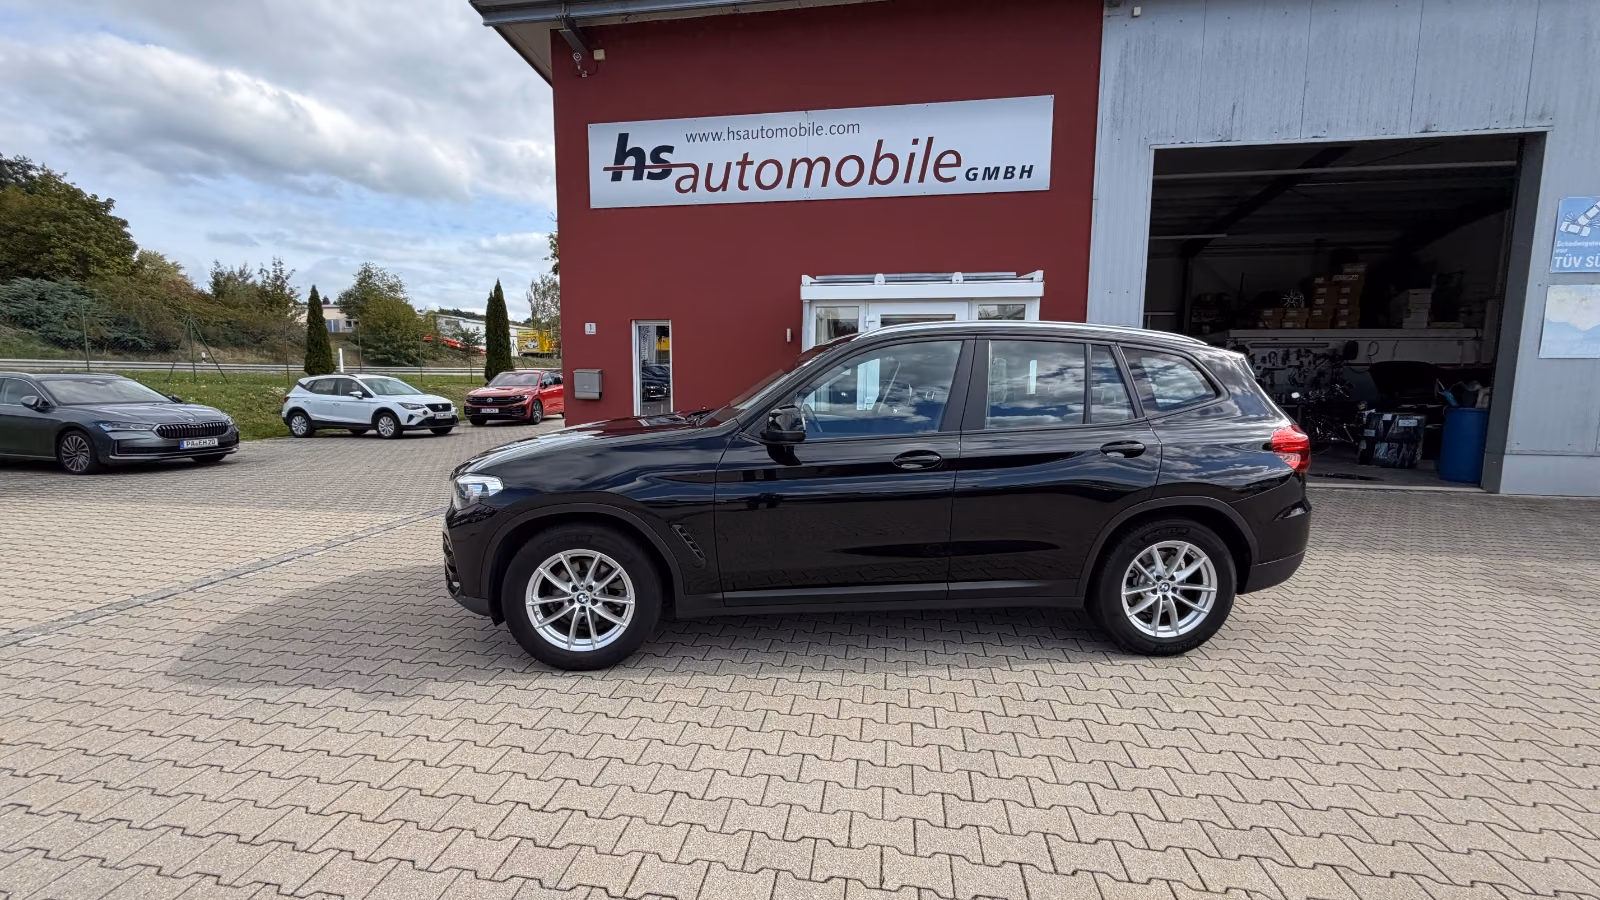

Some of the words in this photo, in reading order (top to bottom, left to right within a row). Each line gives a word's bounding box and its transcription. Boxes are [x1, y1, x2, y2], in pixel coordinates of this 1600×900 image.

[685, 121, 861, 143] www.hsautomobile.com
[964, 164, 1034, 182] GMBH
[1554, 253, 1582, 268] TÜV
